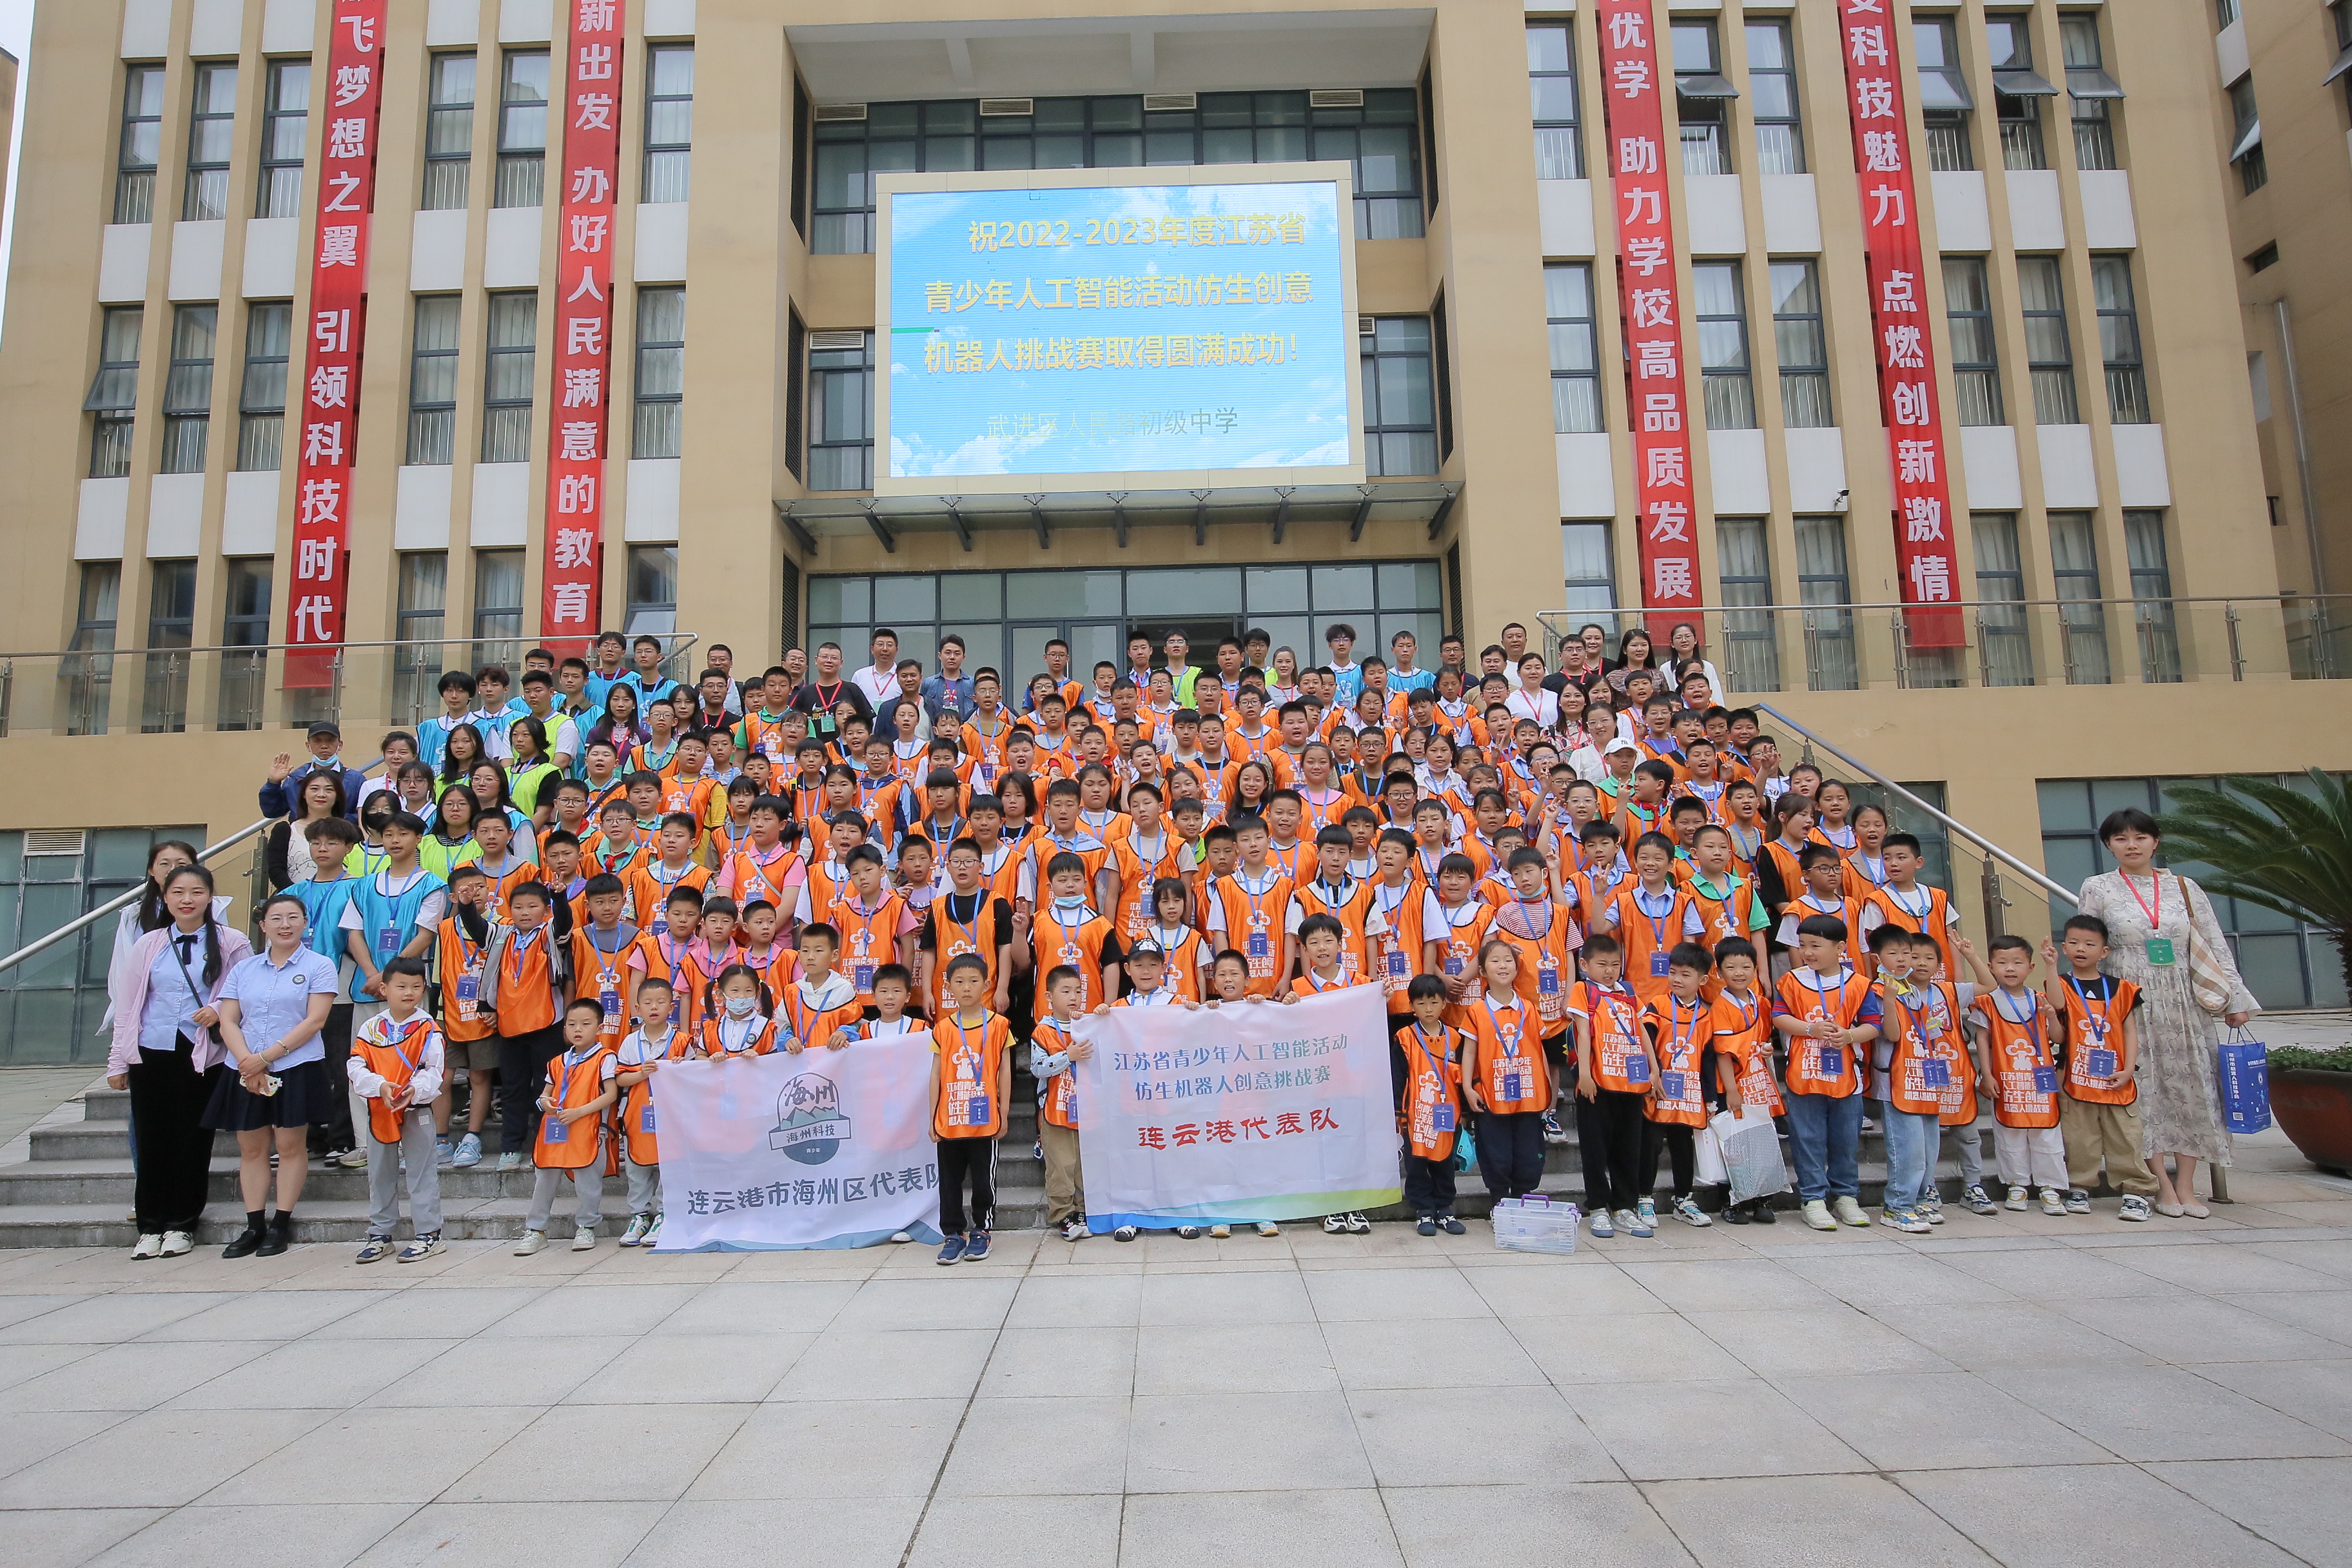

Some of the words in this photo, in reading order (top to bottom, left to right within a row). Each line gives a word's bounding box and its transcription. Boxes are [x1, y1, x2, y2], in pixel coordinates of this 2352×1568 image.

[574, 0, 616, 131] 新出发
[1609, 12, 1651, 99] 优学
[320, 15, 375, 267] 飞梦想之翼
[968, 212, 1306, 253] 祝2022-2023年度江苏省
[924, 271, 1313, 313] 青少年人工智能活动仿生创意
[923, 331, 1298, 375] 机器人挑战赛取得圆满成功！
[1620, 136, 1694, 600] 助力学校高品质发展
[553, 166, 611, 623] 办好人民满意的教育
[987, 406, 1238, 439] 武进区人民路初级中学
[1883, 269, 1950, 602] 点燃创新激情
[294, 308, 351, 642] 引领科技时代
[1114, 1033, 1348, 1072] 江苏省青少年人工智能活动
[1135, 1064, 1331, 1101] 仿生机器人创意挑战赛
[2003, 1090, 2050, 1104] 仿生创意
[1656, 1100, 1702, 1113] 机器人挑战赛
[2004, 1103, 2051, 1114] 机器人挑战赛
[786, 1124, 835, 1144] 海州科技
[1137, 1107, 1340, 1150] 连云港代表队
[688, 1163, 940, 1216] 连云港市海州区代表队
